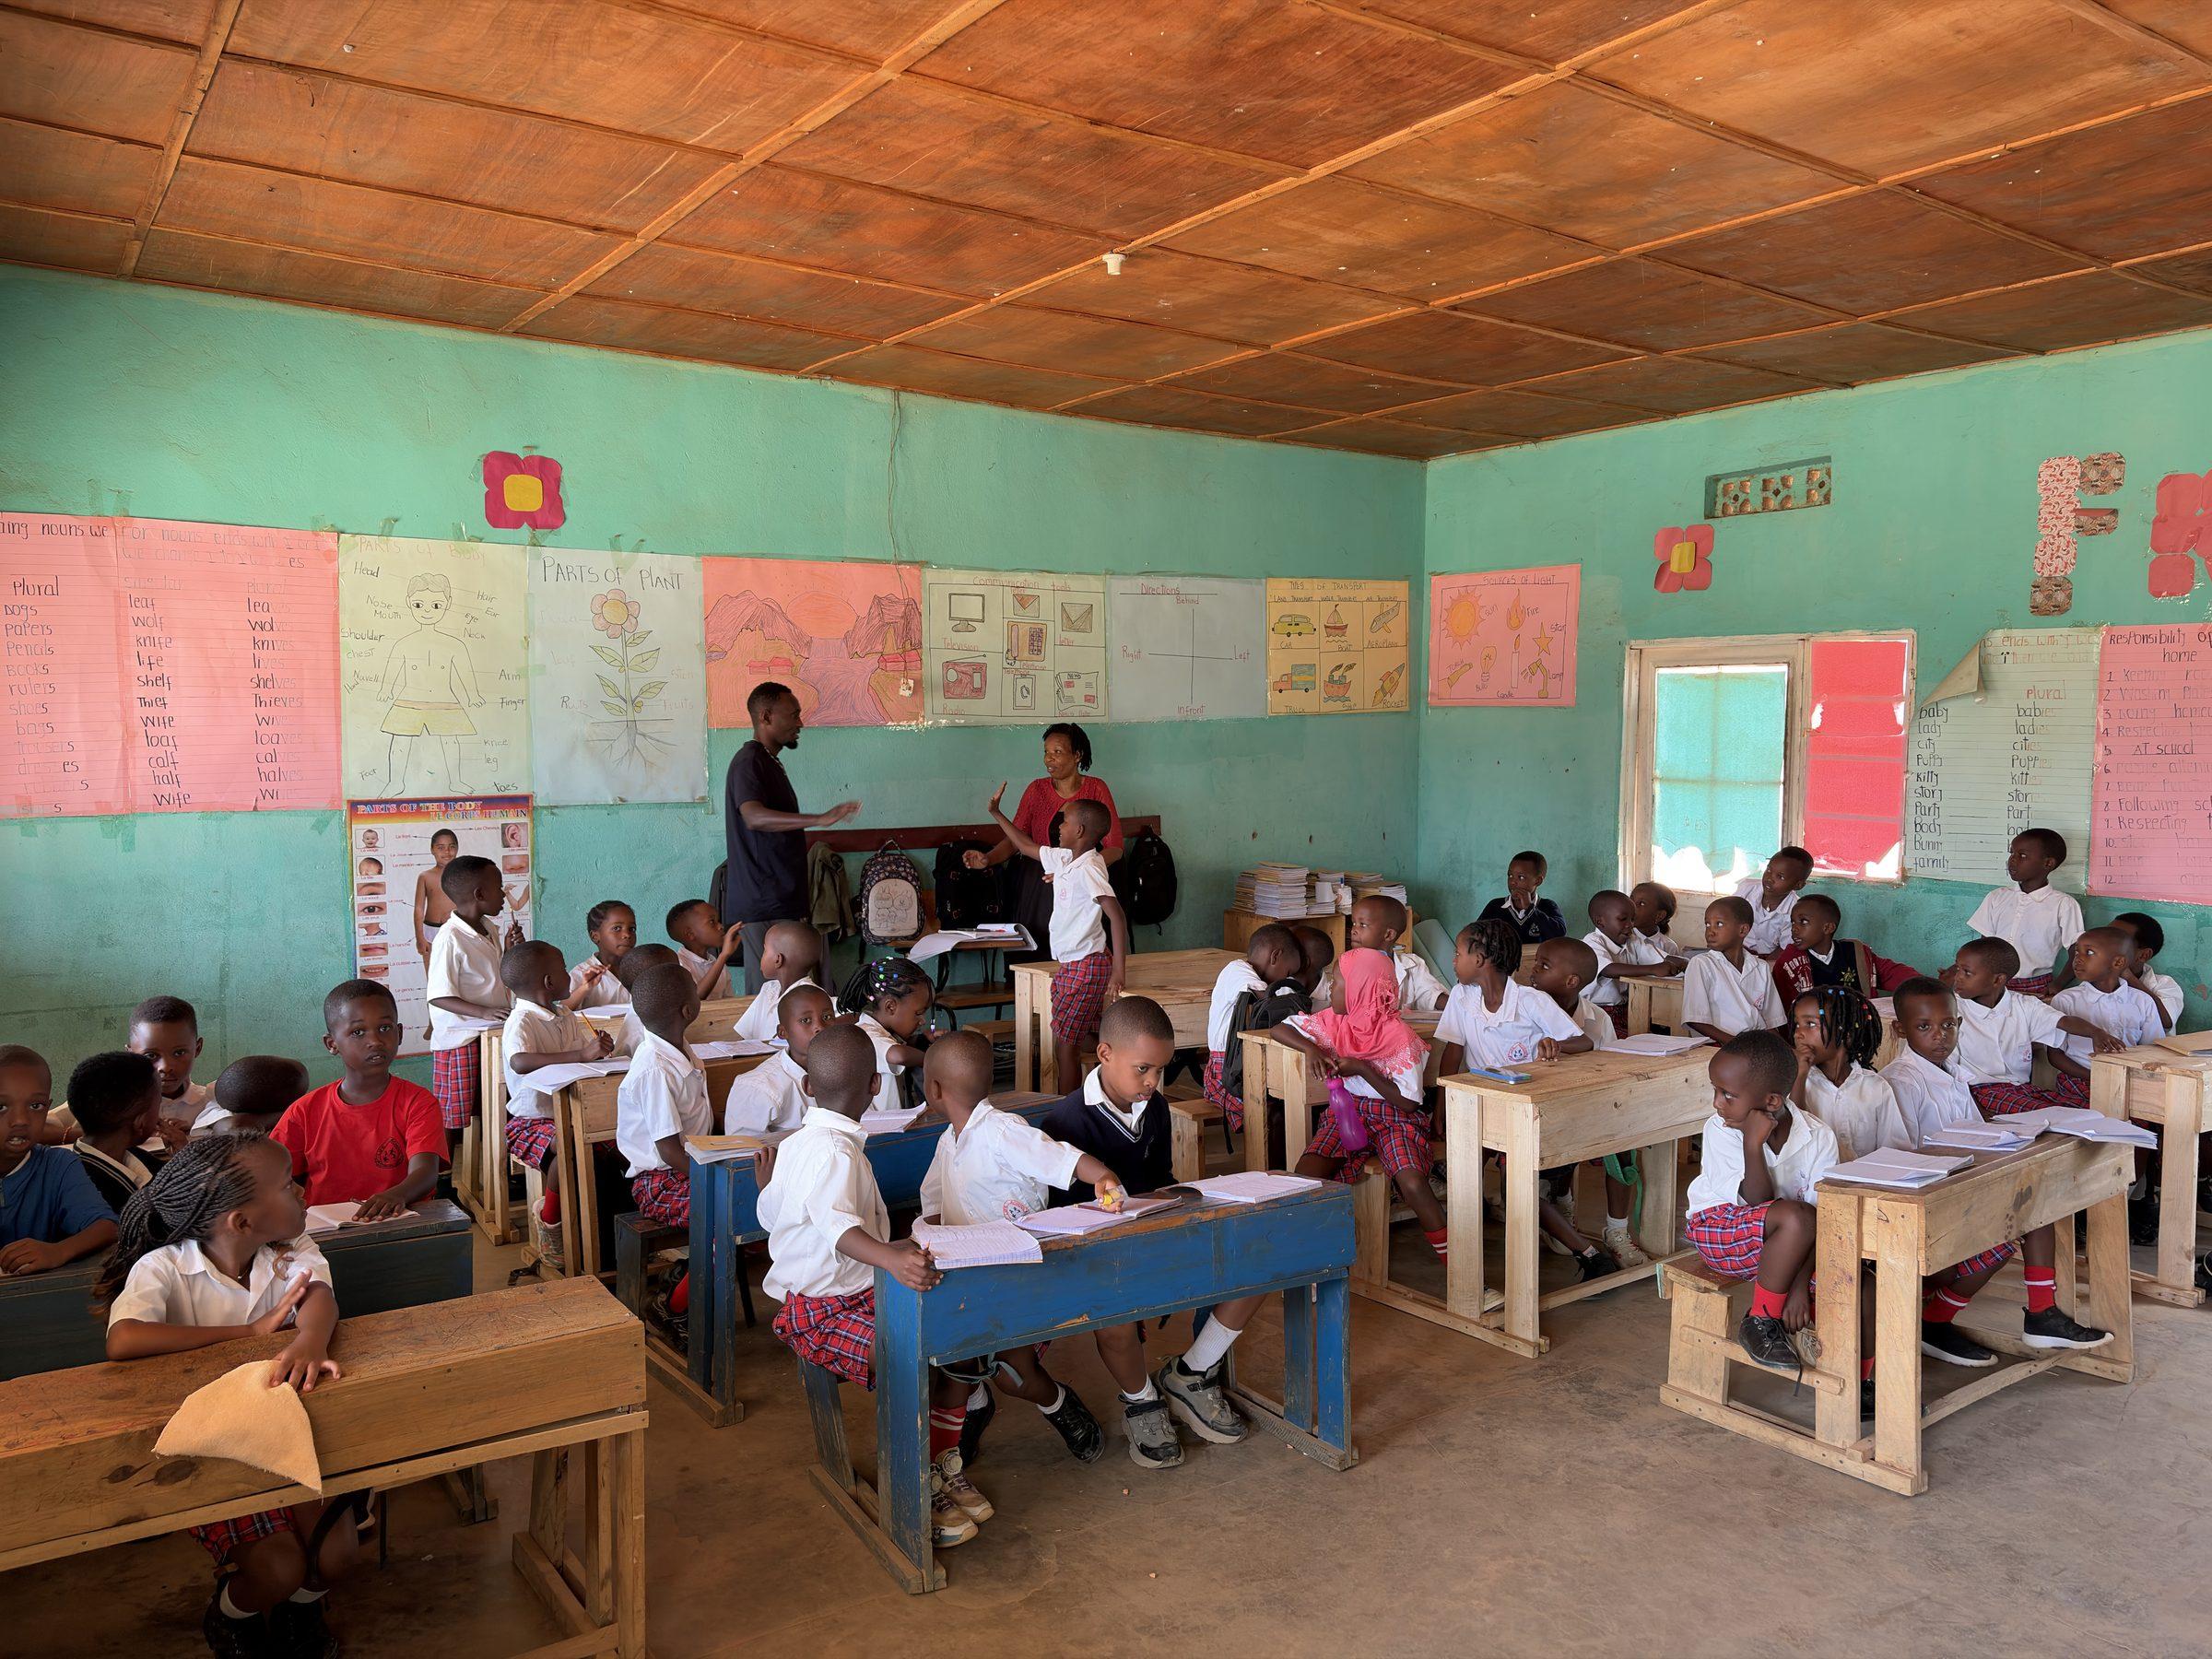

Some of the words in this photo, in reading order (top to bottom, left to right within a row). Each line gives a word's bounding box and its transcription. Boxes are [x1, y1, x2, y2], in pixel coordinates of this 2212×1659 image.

[41, 524, 85, 537] nouns
[2030, 452, 2125, 616] F
[353, 561, 381, 578] Head
[542, 556, 600, 582] PARTS
[604, 567, 623, 585] OF
[1140, 582, 1181, 594] Directions
[129, 594, 155, 611] leaf
[366, 594, 393, 610] Nose
[1176, 595, 1200, 605] Behind
[132, 613, 163, 630] wolf
[135, 635, 172, 650] knife
[136, 651, 163, 670] life
[1233, 644, 1251, 663] Left
[2162, 648, 2197, 663] home
[499, 669, 522, 681] Arm
[8, 677, 56, 696] rulers
[1919, 701, 1948, 724] baby
[16, 720, 54, 738] bags
[1918, 721, 1942, 737] lady
[145, 729, 178, 751] loaf
[1917, 737, 1936, 753] city
[148, 750, 179, 770] calf
[152, 771, 182, 788] half
[357, 803, 397, 814] PARTS
[399, 802, 417, 813] OF
[419, 801, 445, 812] THE
[448, 800, 482, 811] BODY
[446, 810, 480, 820] CORPS
[483, 808, 527, 818] HUMAIN
[2118, 796, 2179, 816] Following
[2118, 814, 2188, 833] Respecting
